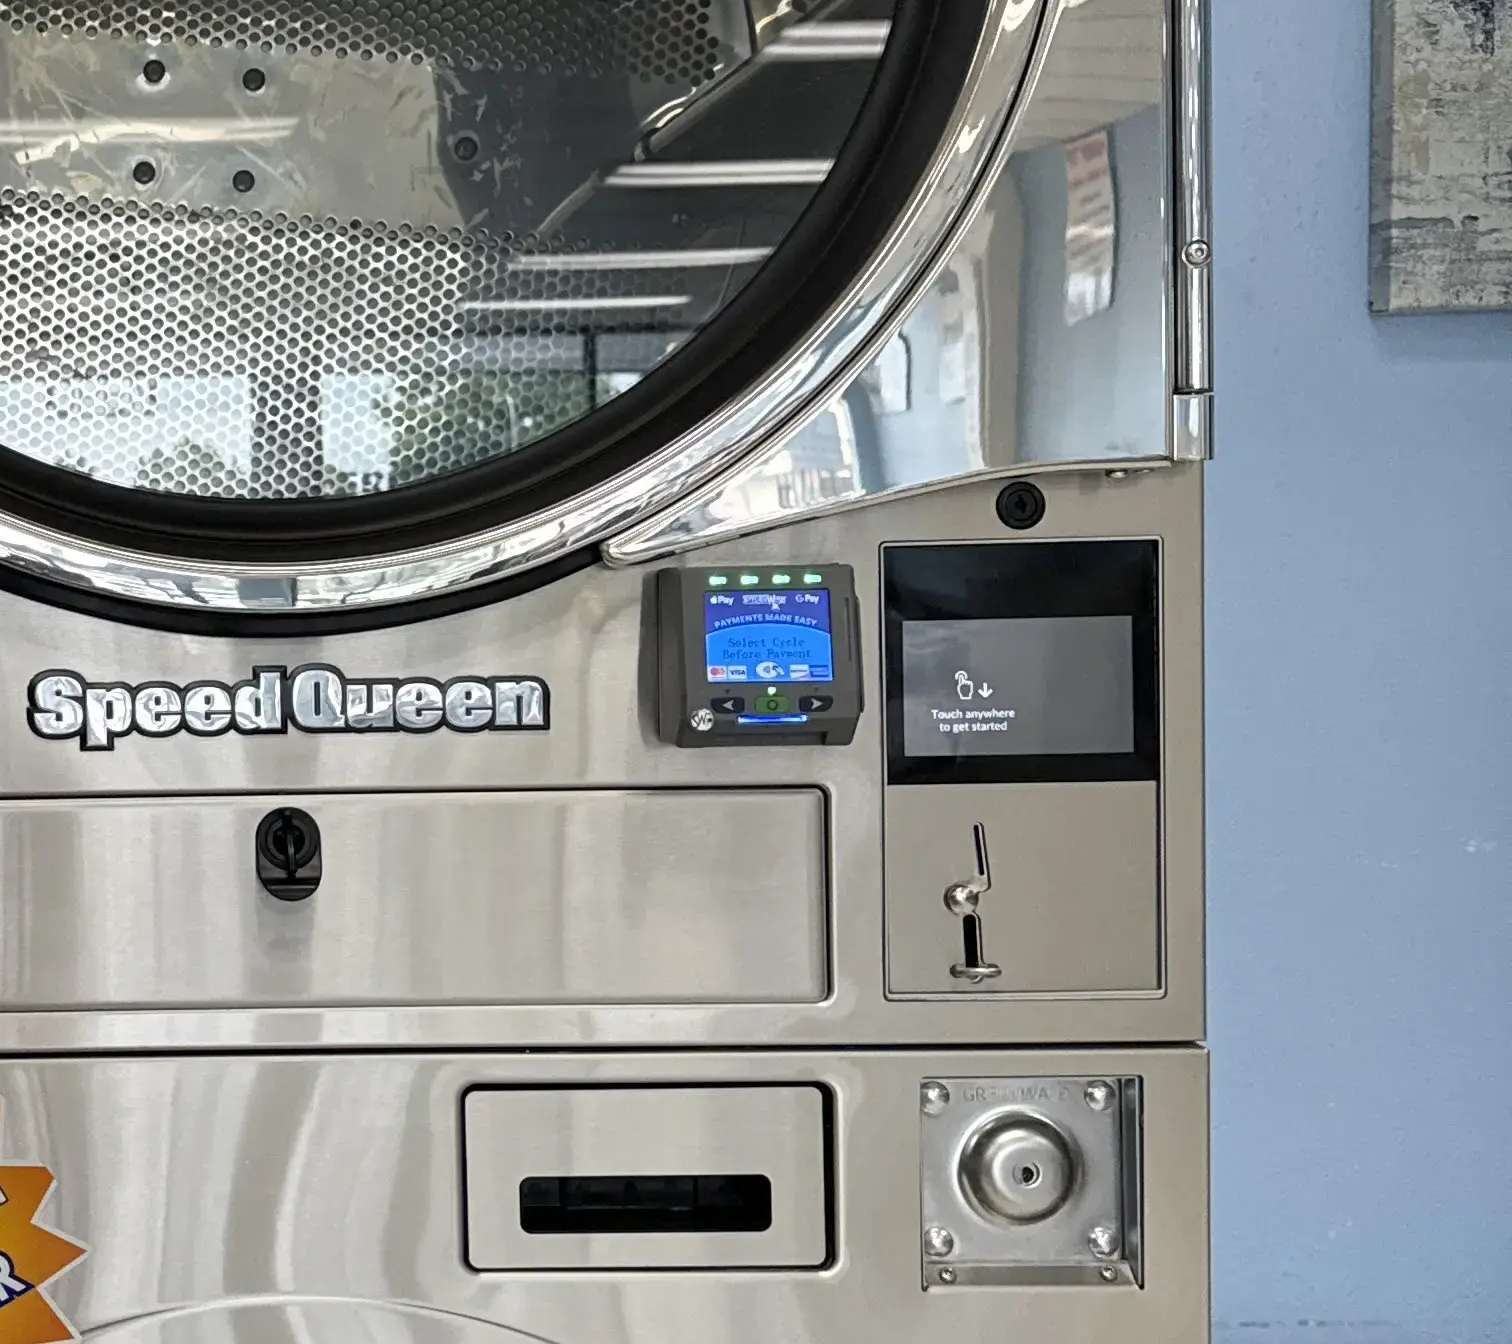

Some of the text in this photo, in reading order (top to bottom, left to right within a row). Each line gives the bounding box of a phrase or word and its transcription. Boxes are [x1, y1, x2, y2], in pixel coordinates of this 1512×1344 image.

[718, 595, 734, 605] Pay
[805, 594, 819, 604] Pay
[714, 614, 817, 628] PAYMENTS MADE EASY
[728, 637, 805, 648] Select Cycle
[722, 649, 812, 660] Before Payment
[27, 663, 550, 750] Speed Queen
[931, 708, 1015, 720] Touch anywhere
[939, 721, 1007, 733] to get started
